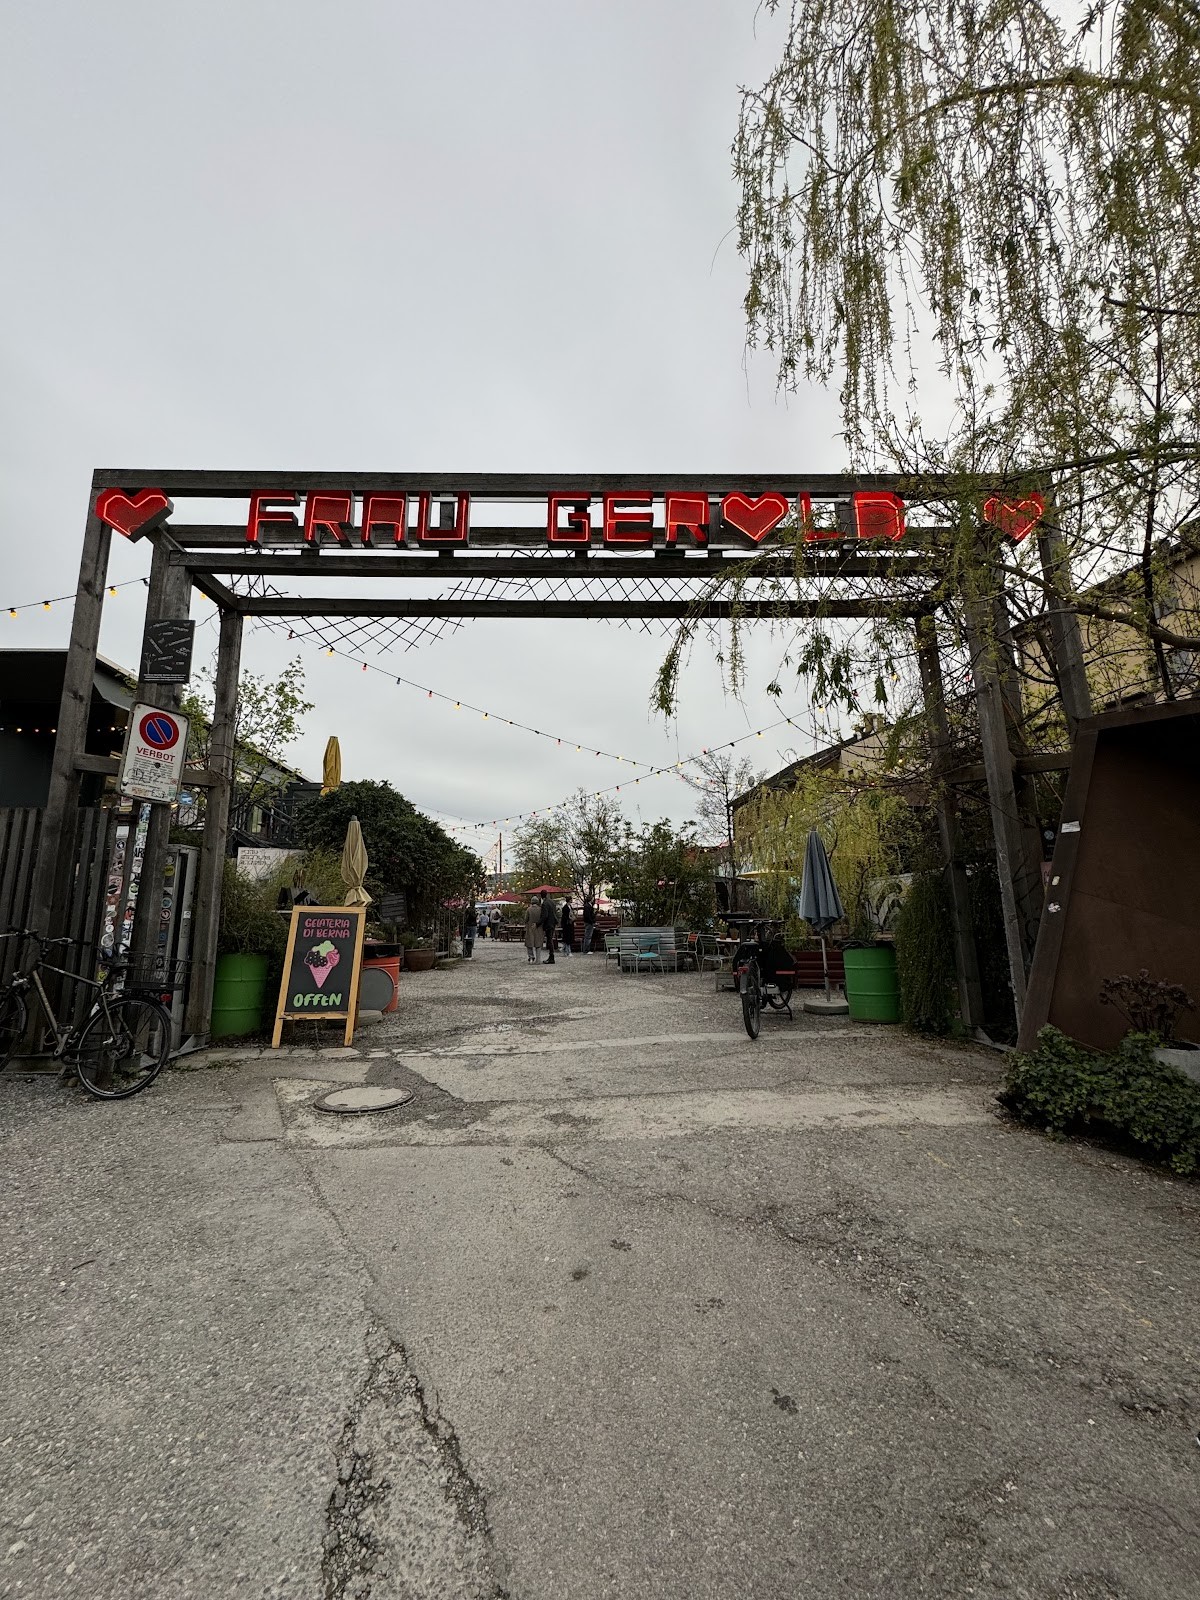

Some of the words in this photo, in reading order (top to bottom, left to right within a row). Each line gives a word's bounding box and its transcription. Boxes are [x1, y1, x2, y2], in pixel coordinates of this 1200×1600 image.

[246, 489, 471, 548] FRAU
[136, 746, 176, 762] VERBOT
[304, 918, 350, 929] GELATERIA
[303, 928, 314, 938] DI
[316, 928, 350, 939] BERNA
